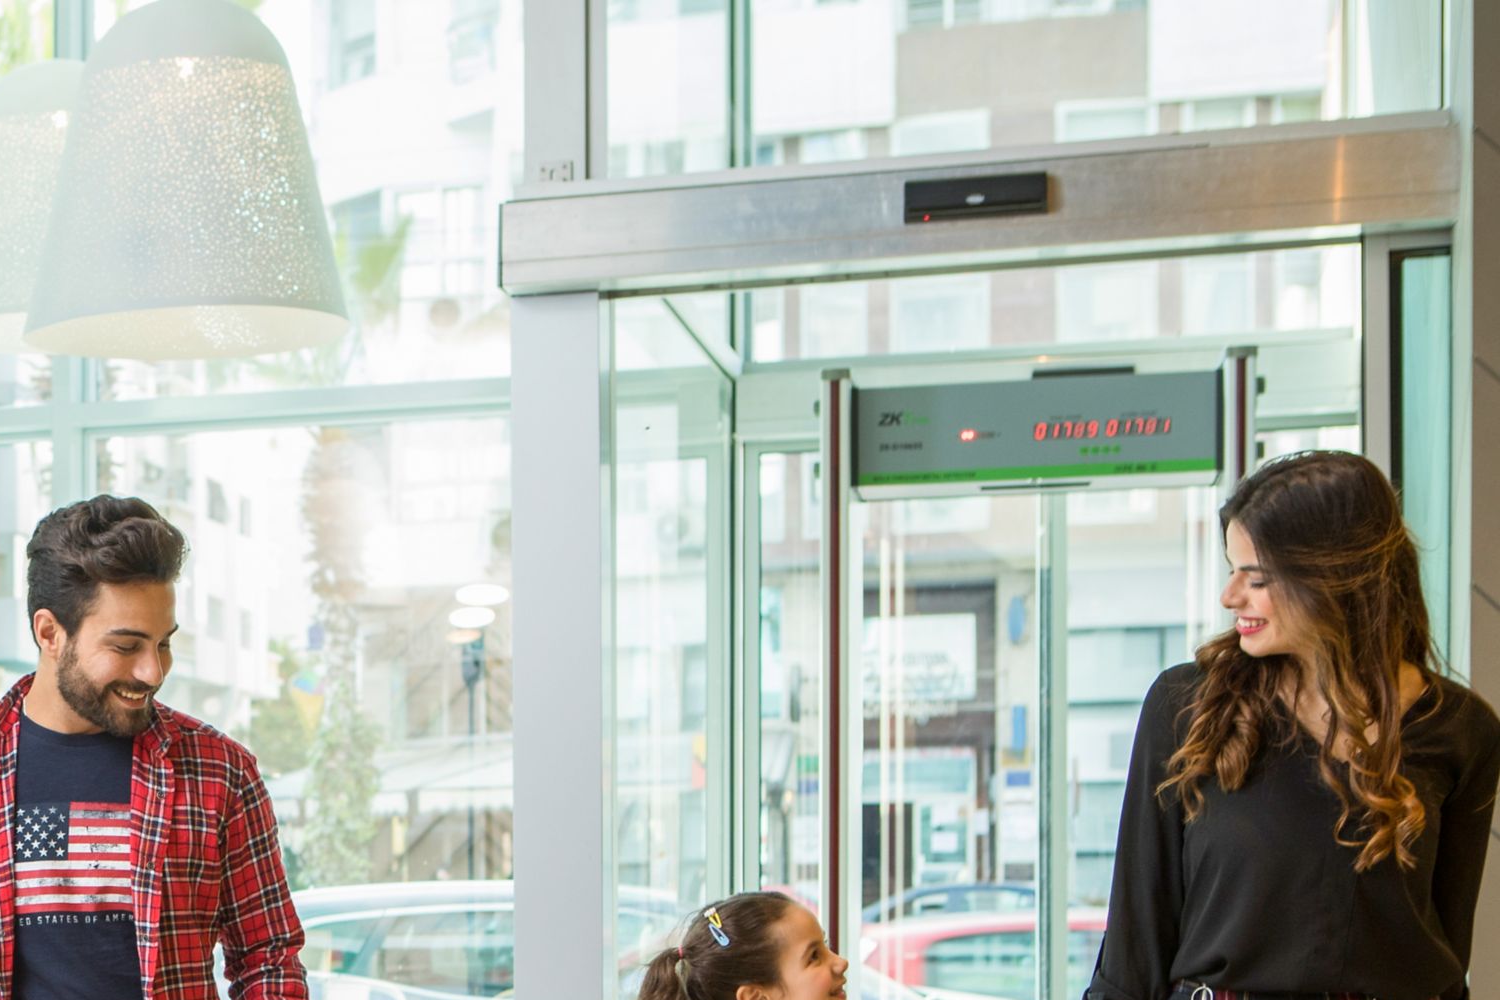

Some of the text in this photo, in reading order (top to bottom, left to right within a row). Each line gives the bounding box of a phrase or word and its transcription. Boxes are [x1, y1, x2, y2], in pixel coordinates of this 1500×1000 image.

[37, 915, 79, 925] STATES
[85, 915, 98, 924] OF
[105, 913, 134, 923] AMER
